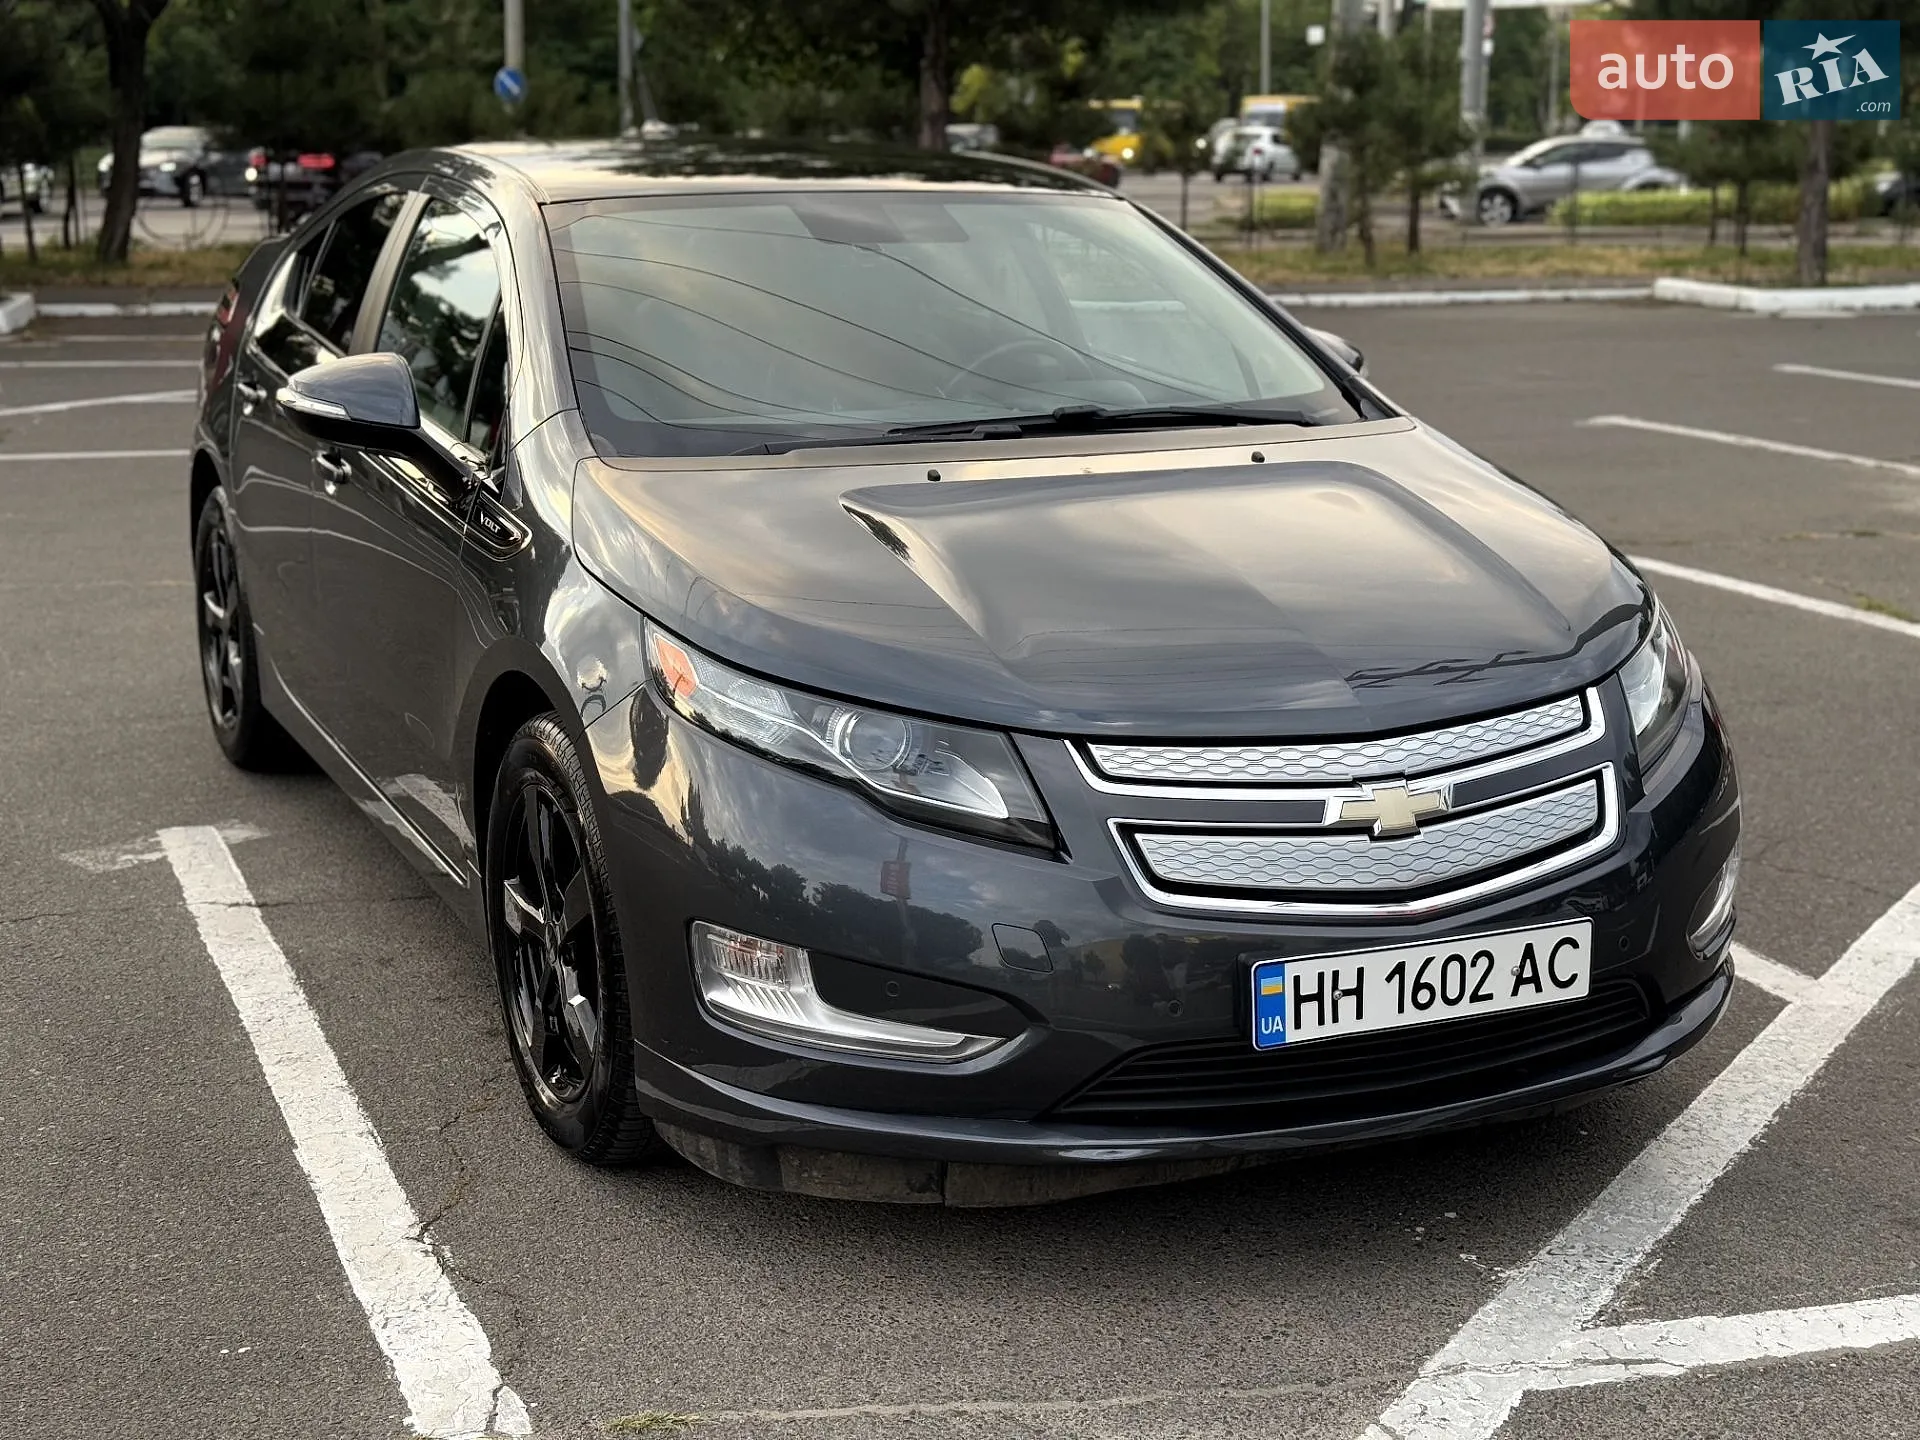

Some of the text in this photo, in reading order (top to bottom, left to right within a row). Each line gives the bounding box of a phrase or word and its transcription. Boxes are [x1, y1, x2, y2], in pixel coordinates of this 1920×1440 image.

[480, 511, 501, 533] VOLT
[1293, 937, 1580, 1030] HH 1602 AC
[1261, 1016, 1284, 1035] UA
